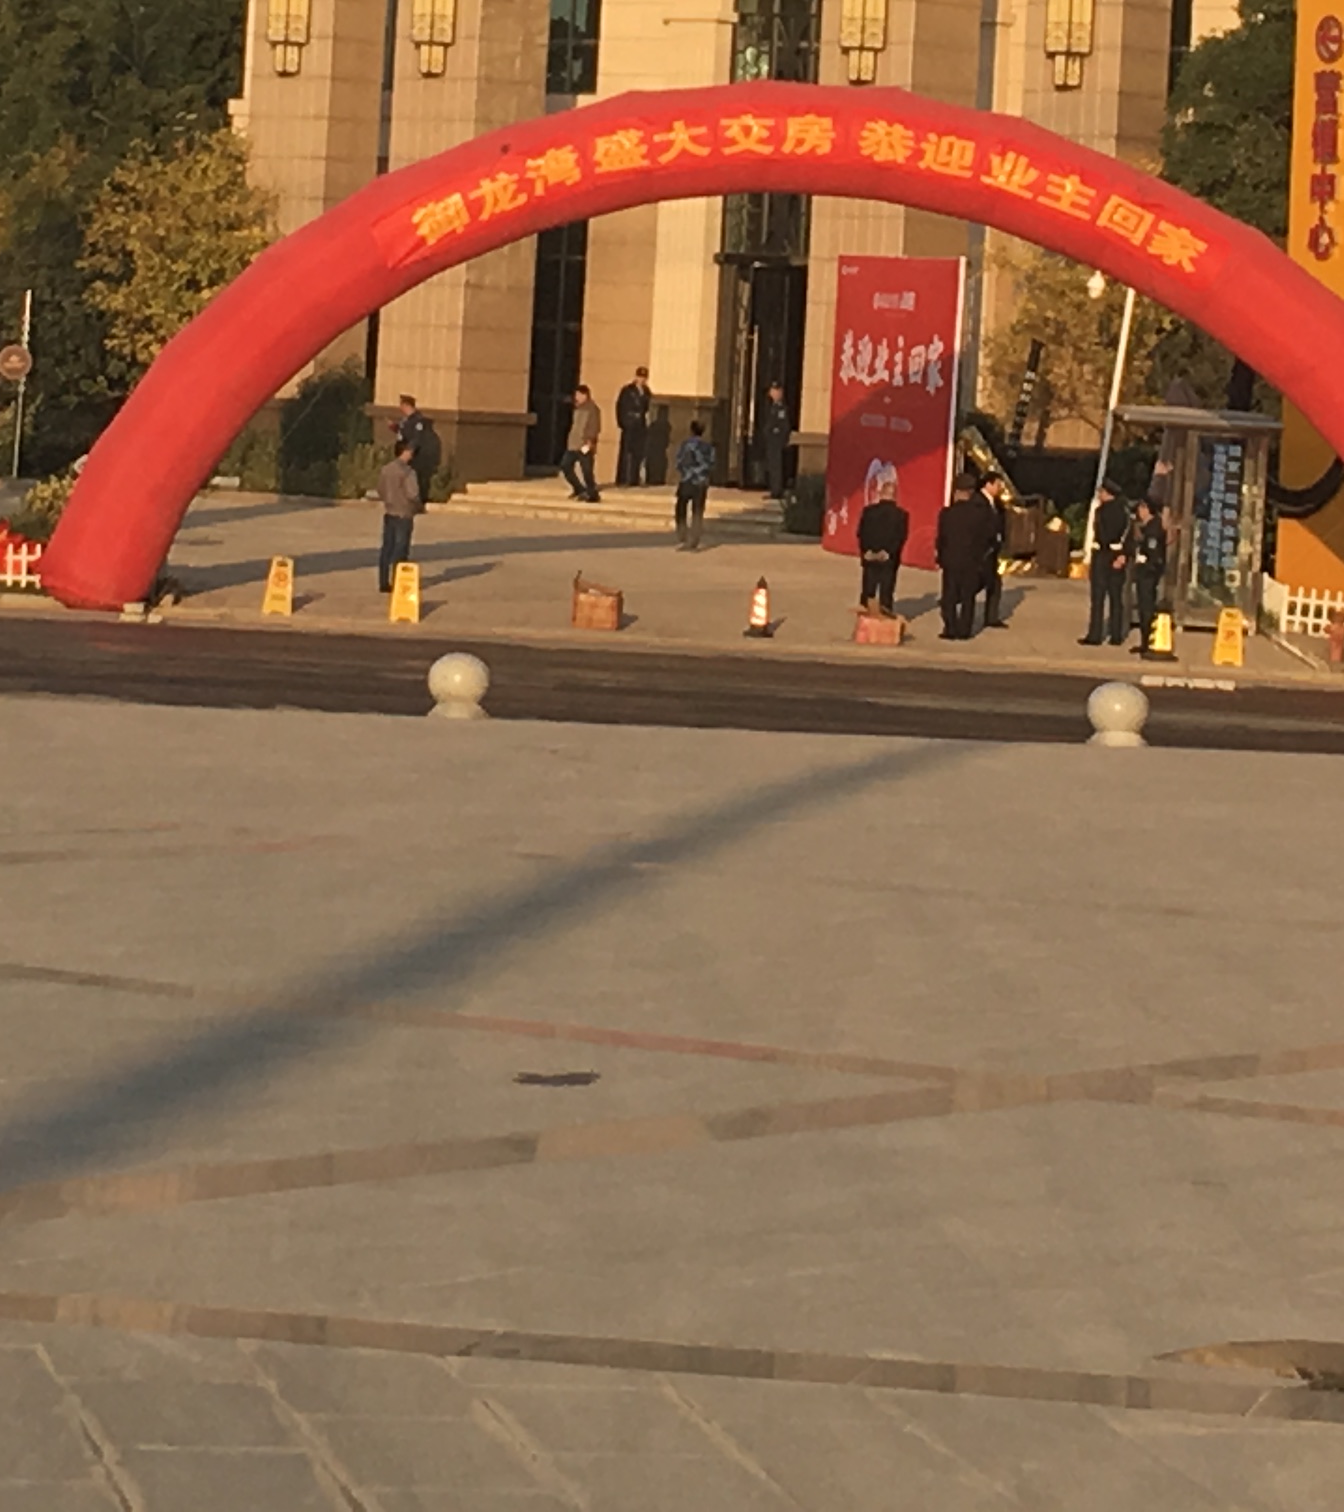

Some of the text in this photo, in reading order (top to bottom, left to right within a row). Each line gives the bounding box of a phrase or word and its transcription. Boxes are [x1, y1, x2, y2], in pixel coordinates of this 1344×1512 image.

[411, 113, 1210, 275] 御龙湾盛大交房 恭迎业主回家
